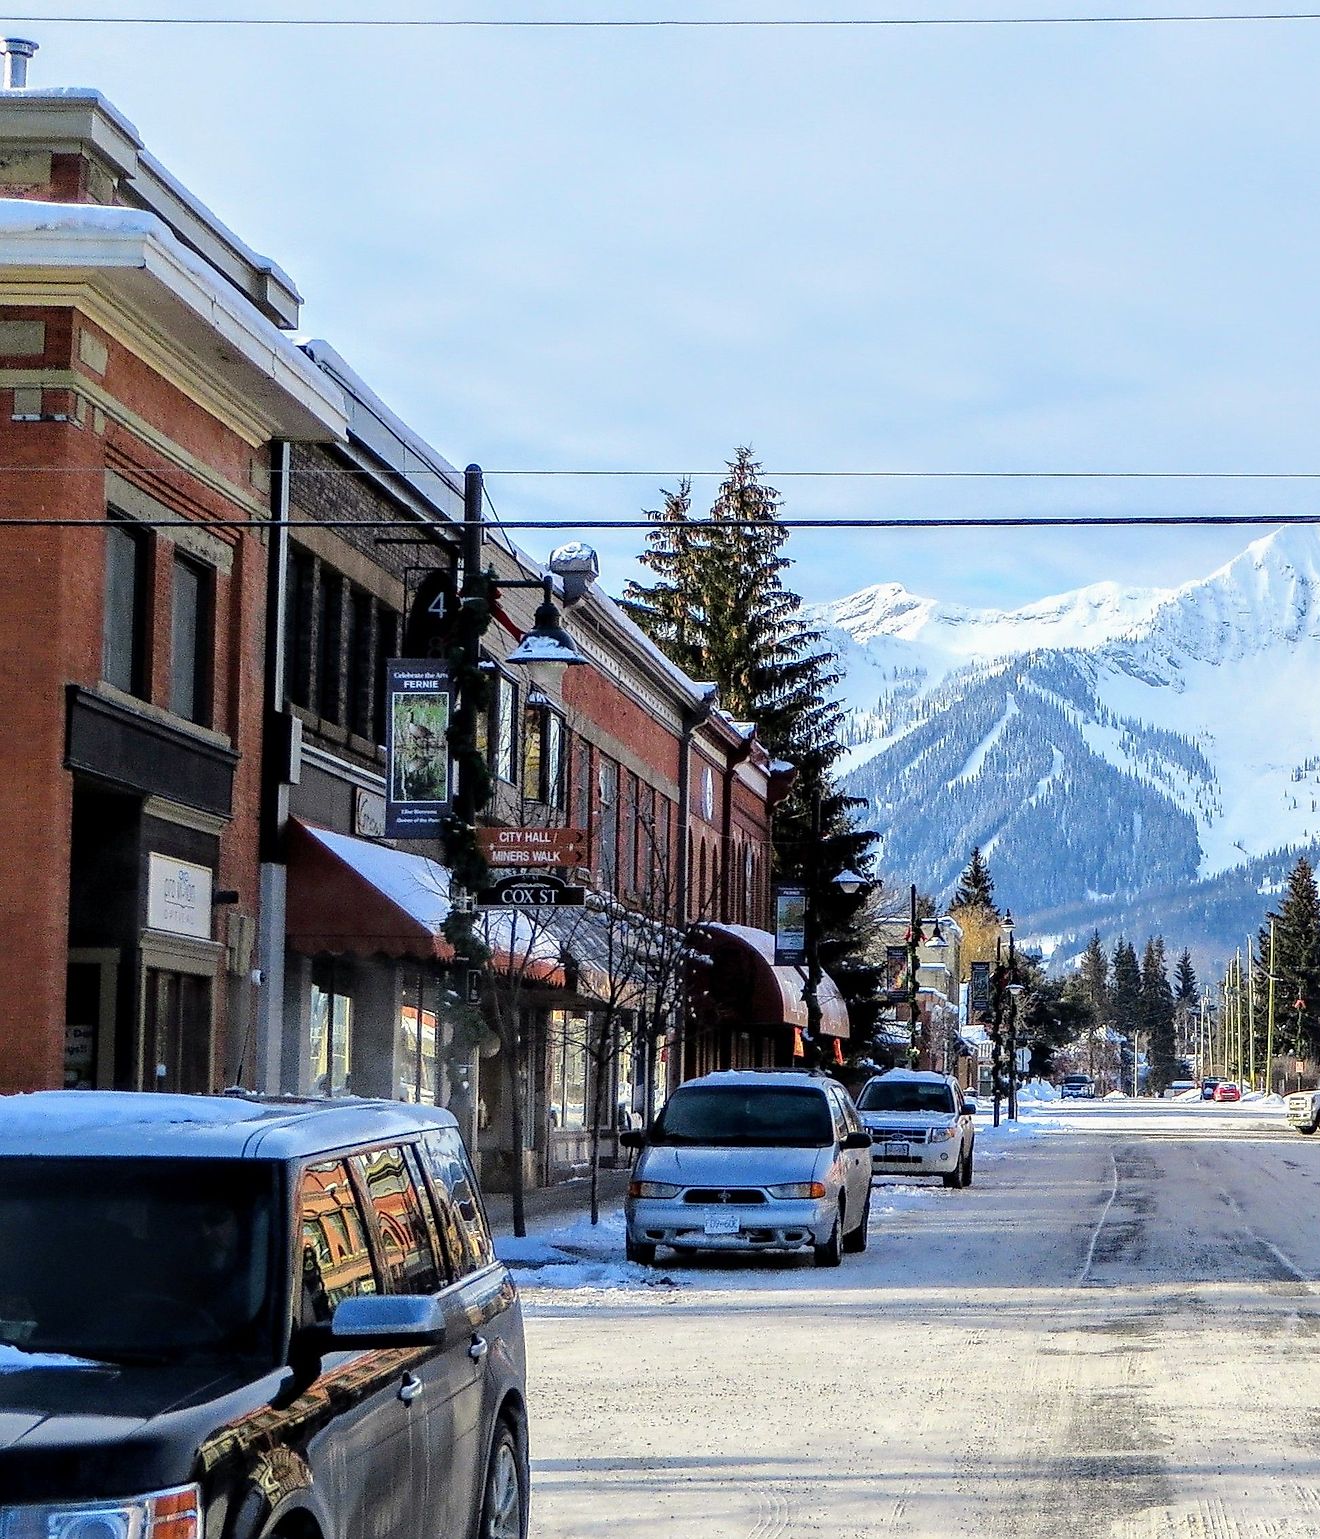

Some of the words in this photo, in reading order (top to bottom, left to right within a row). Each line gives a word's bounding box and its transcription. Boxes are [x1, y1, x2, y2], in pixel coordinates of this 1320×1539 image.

[428, 591, 447, 618] 4
[403, 680, 439, 688] FERNIE
[499, 831, 523, 843] CITY
[525, 831, 552, 843] HALL
[492, 850, 530, 862] MINERS
[532, 850, 561, 862] WALK
[501, 889, 535, 904] COX
[539, 889, 560, 904] ST
